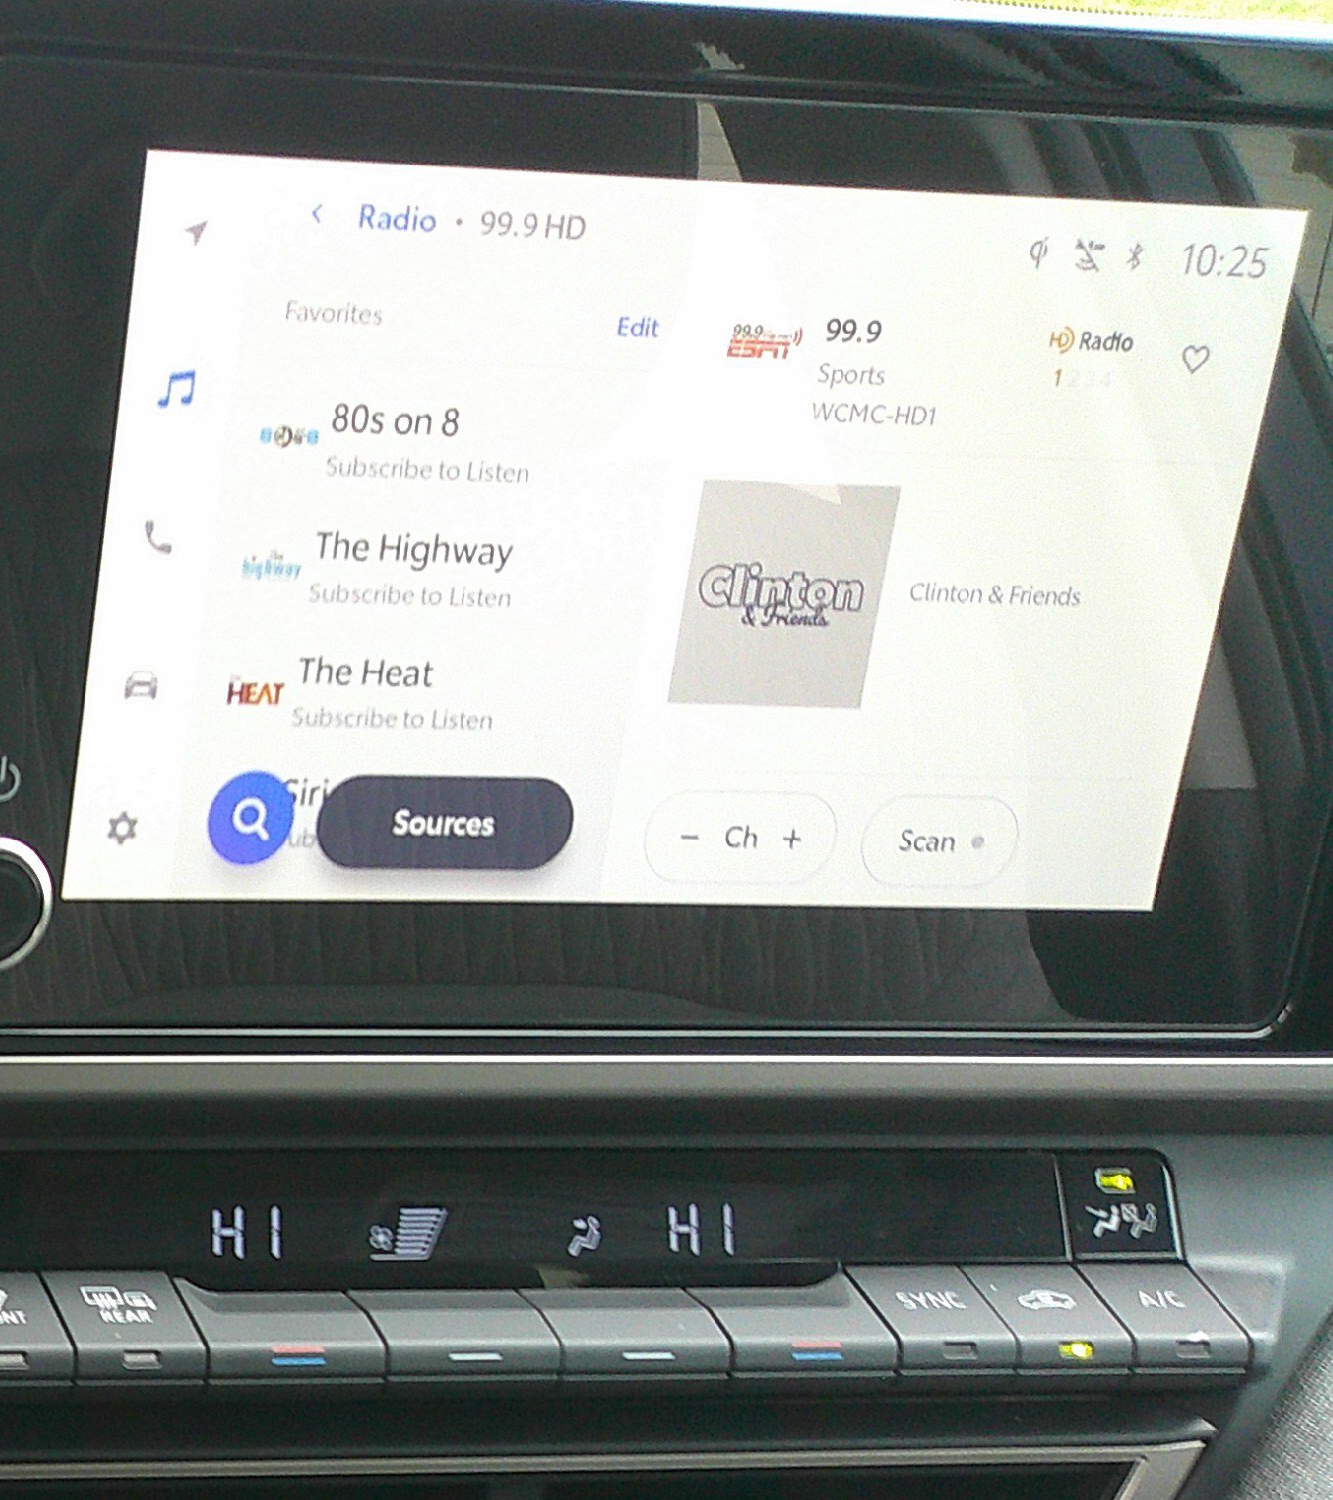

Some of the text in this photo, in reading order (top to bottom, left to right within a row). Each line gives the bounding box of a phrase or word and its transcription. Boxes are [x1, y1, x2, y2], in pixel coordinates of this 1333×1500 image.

[358, 203, 587, 241] Radio 99.9 HD
[1182, 242, 1270, 280] 10:25
[285, 300, 384, 328] Favorites
[617, 316, 660, 339] Edit
[825, 318, 882, 344] 99.9
[1079, 331, 1134, 352] Radio
[818, 363, 886, 387] Sports
[332, 403, 460, 437] 80s on 8
[812, 401, 937, 428] WCMC-HD1
[326, 454, 529, 484] Subscribe to Listen
[317, 532, 514, 573] The Highway
[309, 582, 511, 609] Subscribe to Listen
[699, 563, 864, 613] Clinton
[909, 582, 1082, 608] Clinton & Friends
[759, 604, 829, 628] Friends
[298, 656, 434, 687] The Heat
[226, 682, 284, 705] HEAT
[291, 706, 493, 731] Subscribe to Listen
[391, 809, 495, 838] Sources
[724, 824, 758, 849] Ch
[898, 828, 956, 853] Scan
[211, 1204, 281, 1260] HI
[667, 1202, 735, 1257] HI
[896, 1291, 966, 1310] SYNC
[1139, 1290, 1187, 1309] A/C
[99, 1309, 153, 1324] REAR
